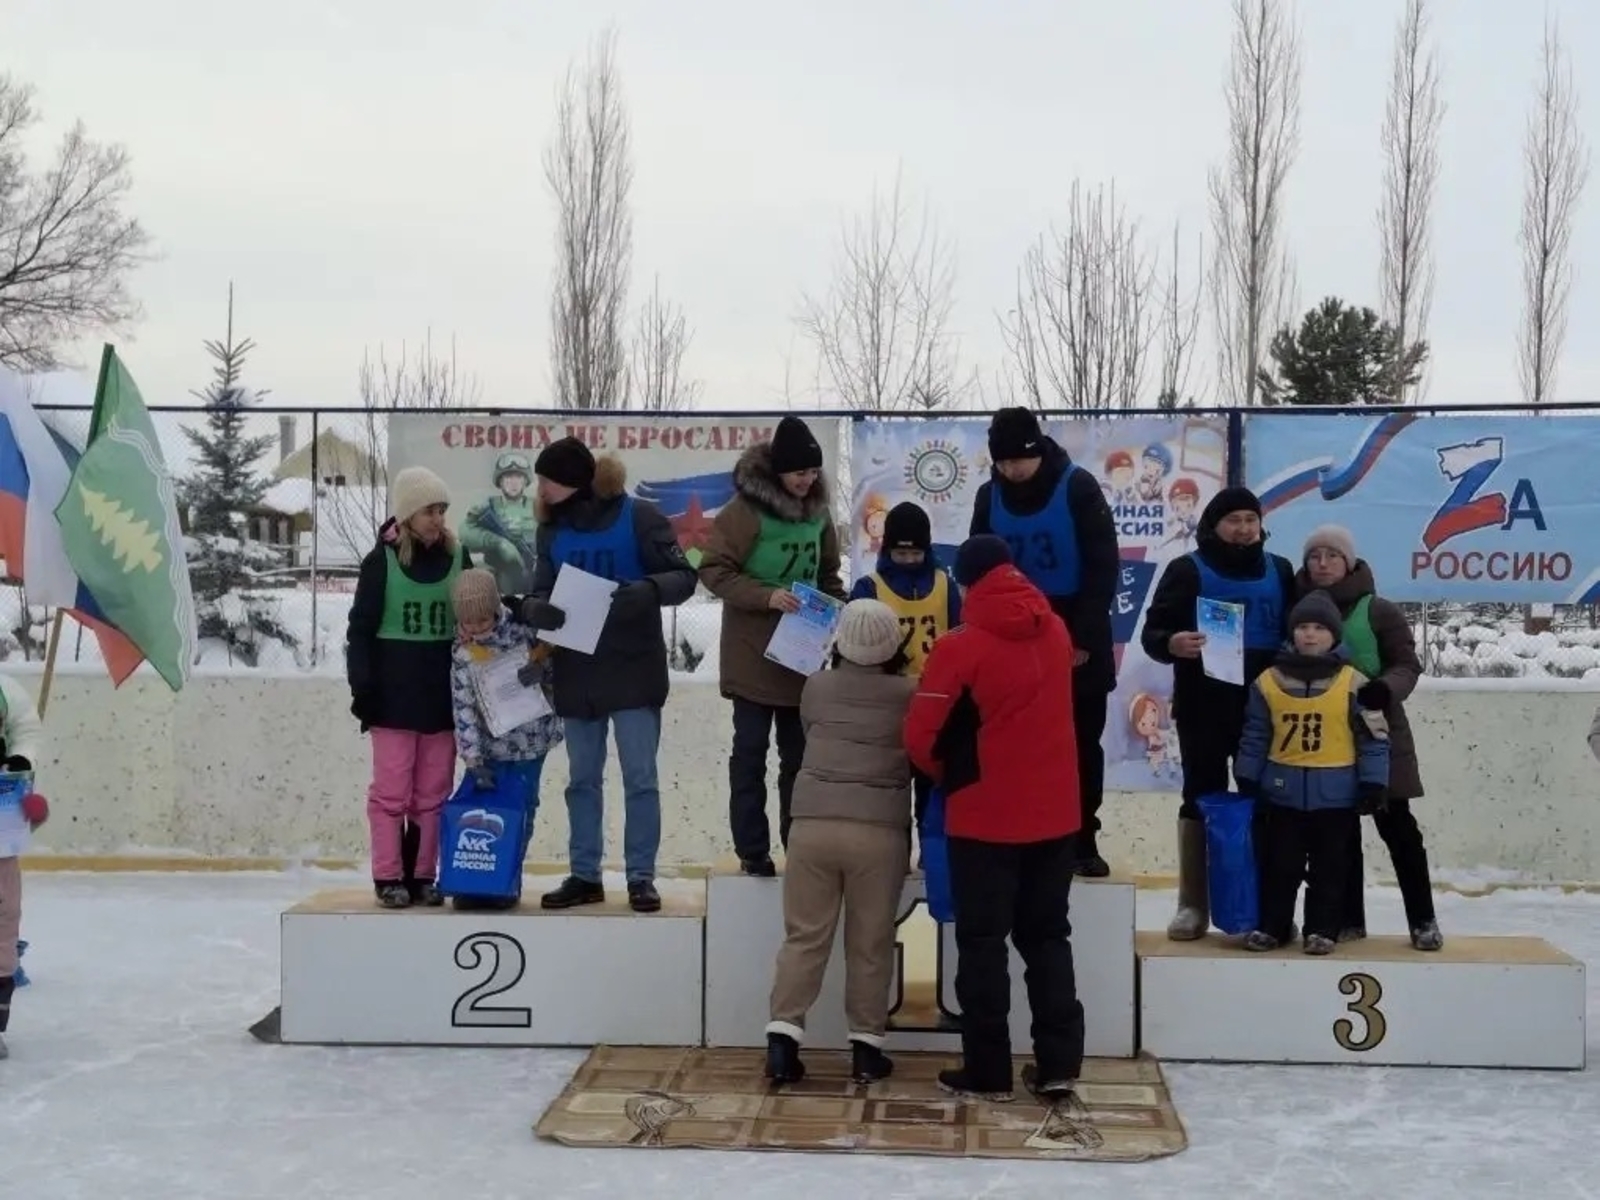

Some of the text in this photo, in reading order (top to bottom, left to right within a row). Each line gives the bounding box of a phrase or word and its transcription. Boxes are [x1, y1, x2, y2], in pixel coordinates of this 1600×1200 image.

[442, 424, 554, 449] СВОИХ
[779, 541, 816, 580] 73
[1411, 551, 1573, 581] РОССИЮ
[402, 601, 446, 635] 80
[898, 614, 936, 654] 73
[1279, 712, 1323, 753] 78
[451, 931, 532, 1028] 2
[1333, 972, 1387, 1052] 3
